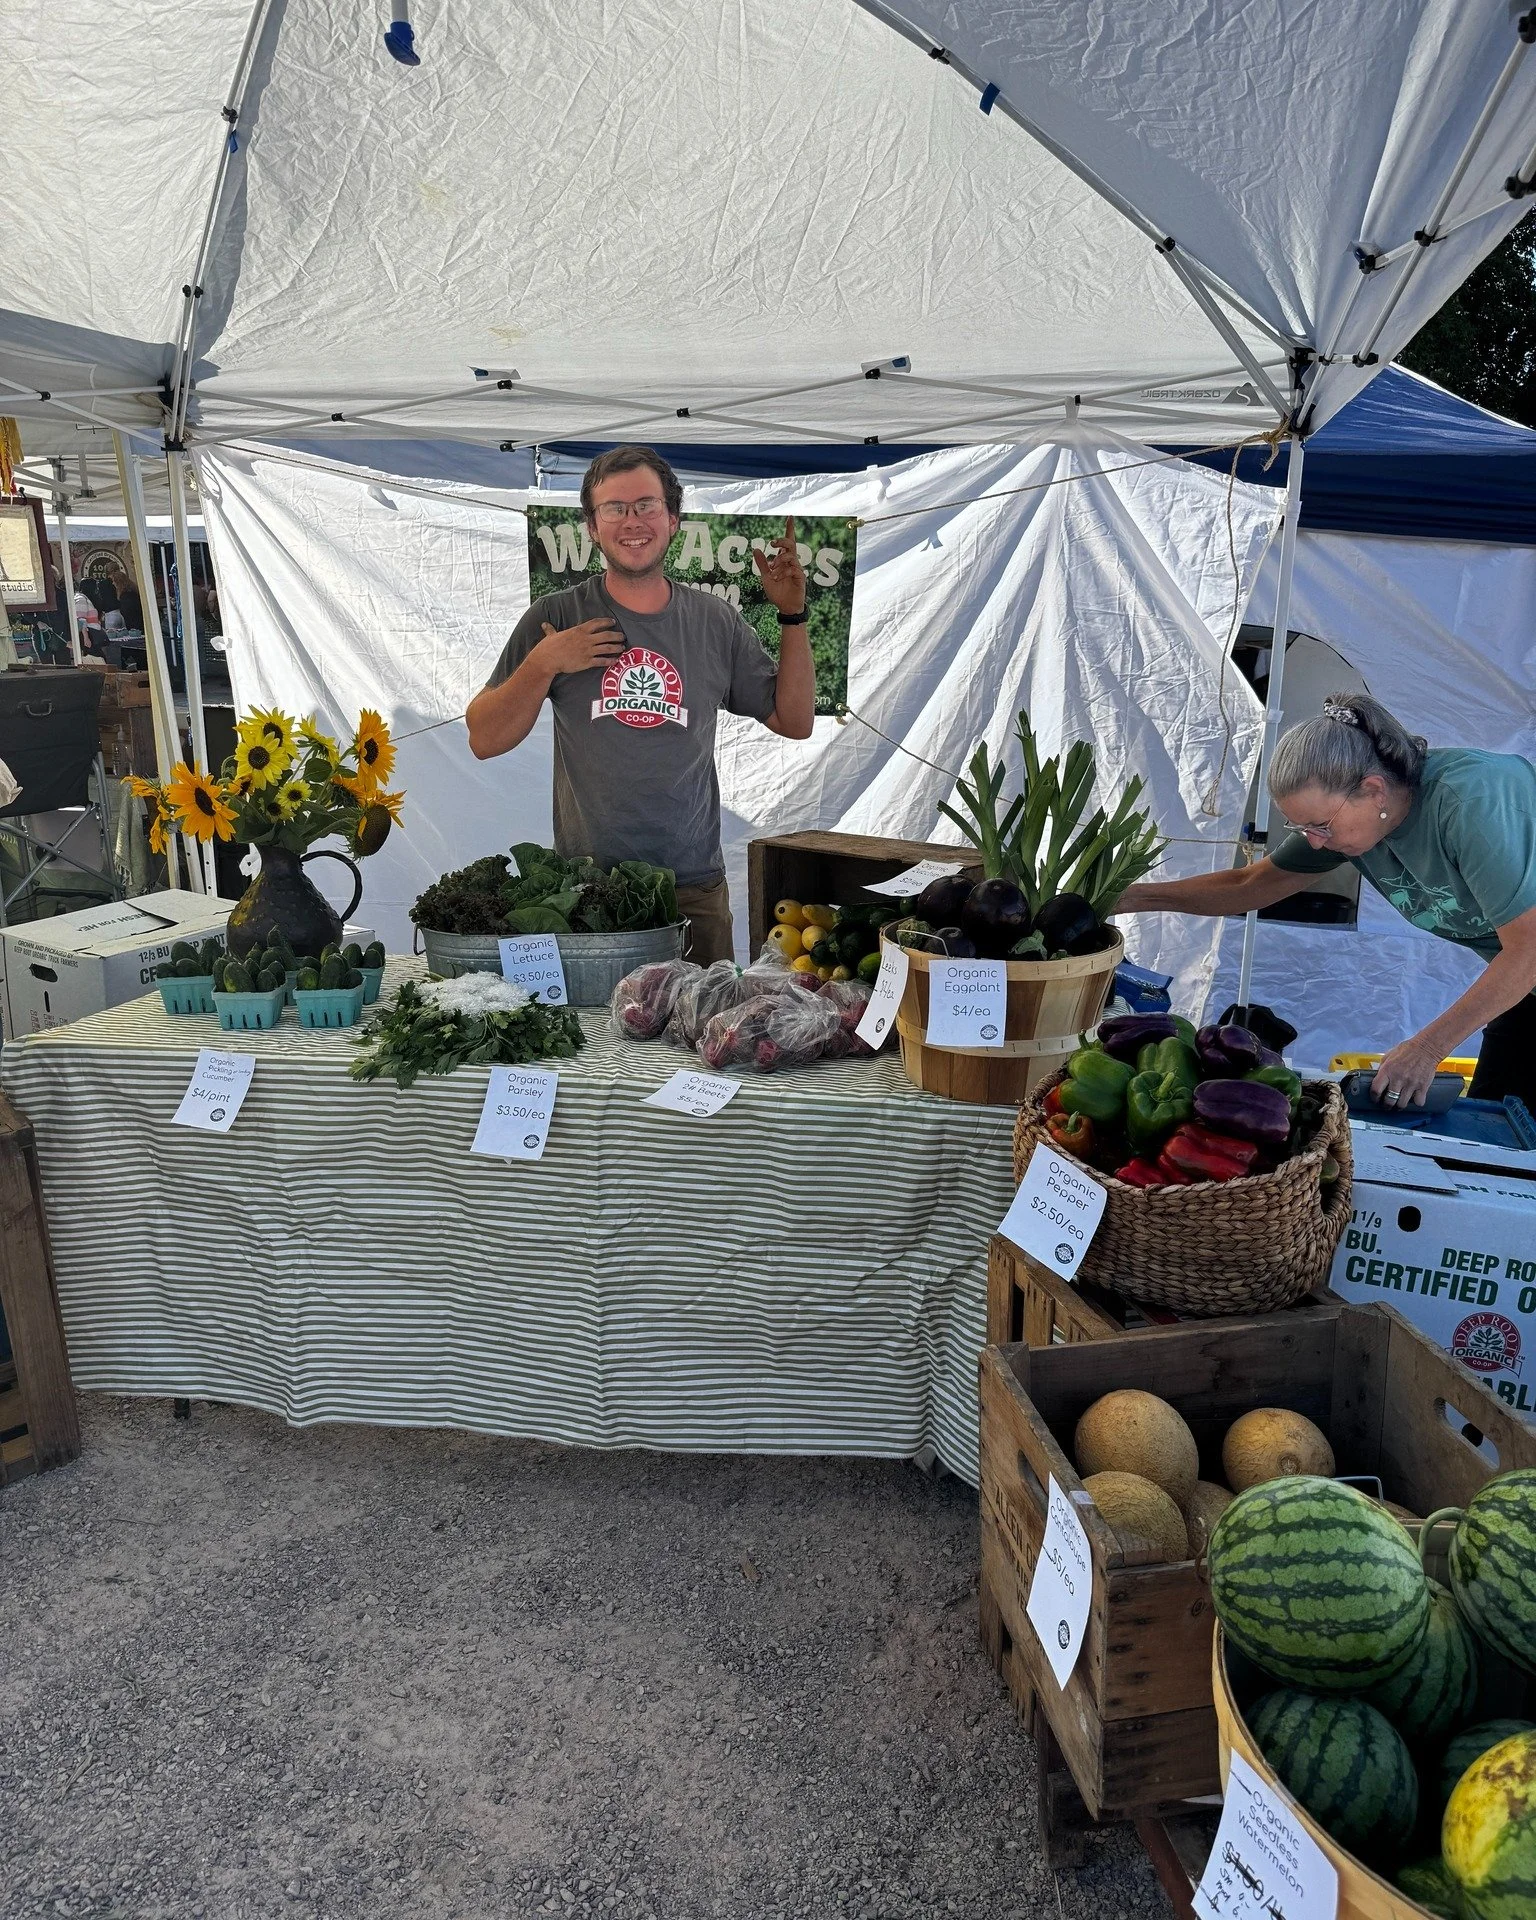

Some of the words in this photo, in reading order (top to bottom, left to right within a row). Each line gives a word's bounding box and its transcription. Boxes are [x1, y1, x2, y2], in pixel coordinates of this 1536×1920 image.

[1, 582, 34, 592] studio
[604, 652, 635, 690] DEEP
[642, 651, 680, 700] ROOT
[604, 697, 676, 716] ORGANIC
[626, 714, 655, 723] CO-OP
[157, 945, 170, 959] BU
[509, 939, 554, 952] Organic
[512, 952, 554, 965] Lettuce
[513, 970, 560, 984] $3.50/ea
[947, 967, 998, 980] Organic
[944, 981, 1001, 994] Eggplant
[952, 1004, 991, 1017] $4/ea
[209, 1056, 236, 1067] Organic
[201, 1071, 235, 1082] Cucumber
[208, 1064, 233, 1076] Pickling
[507, 1073, 548, 1085] Organic
[689, 1076, 732, 1092] Organic
[191, 1087, 232, 1103] $4/pint
[507, 1085, 544, 1098] Parsley
[697, 1087, 726, 1099] Beets
[676, 1095, 710, 1108] $5/ea
[495, 1104, 546, 1120] $3.50/ea
[1049, 1161, 1097, 1201] Organic
[1046, 1176, 1089, 1211] Pepper
[1030, 1196, 1084, 1241] $2.50/ea
[1345, 1229, 1382, 1255] BU.
[1440, 1247, 1500, 1275] DEEP
[1345, 1255, 1499, 1306] CERTIFIED
[1456, 1315, 1485, 1343] DEEP
[1491, 1315, 1518, 1356] ROOT
[1455, 1347, 1512, 1366] ORGANIC
[1056, 1497, 1082, 1546] Organic
[1050, 1505, 1086, 1571] Cantaloupe
[1052, 1548, 1075, 1597] $5/ea
[1252, 1790, 1300, 1850] Organic
[1249, 1805, 1298, 1869] Seedless
[1238, 1809, 1304, 1898] Watermelon
